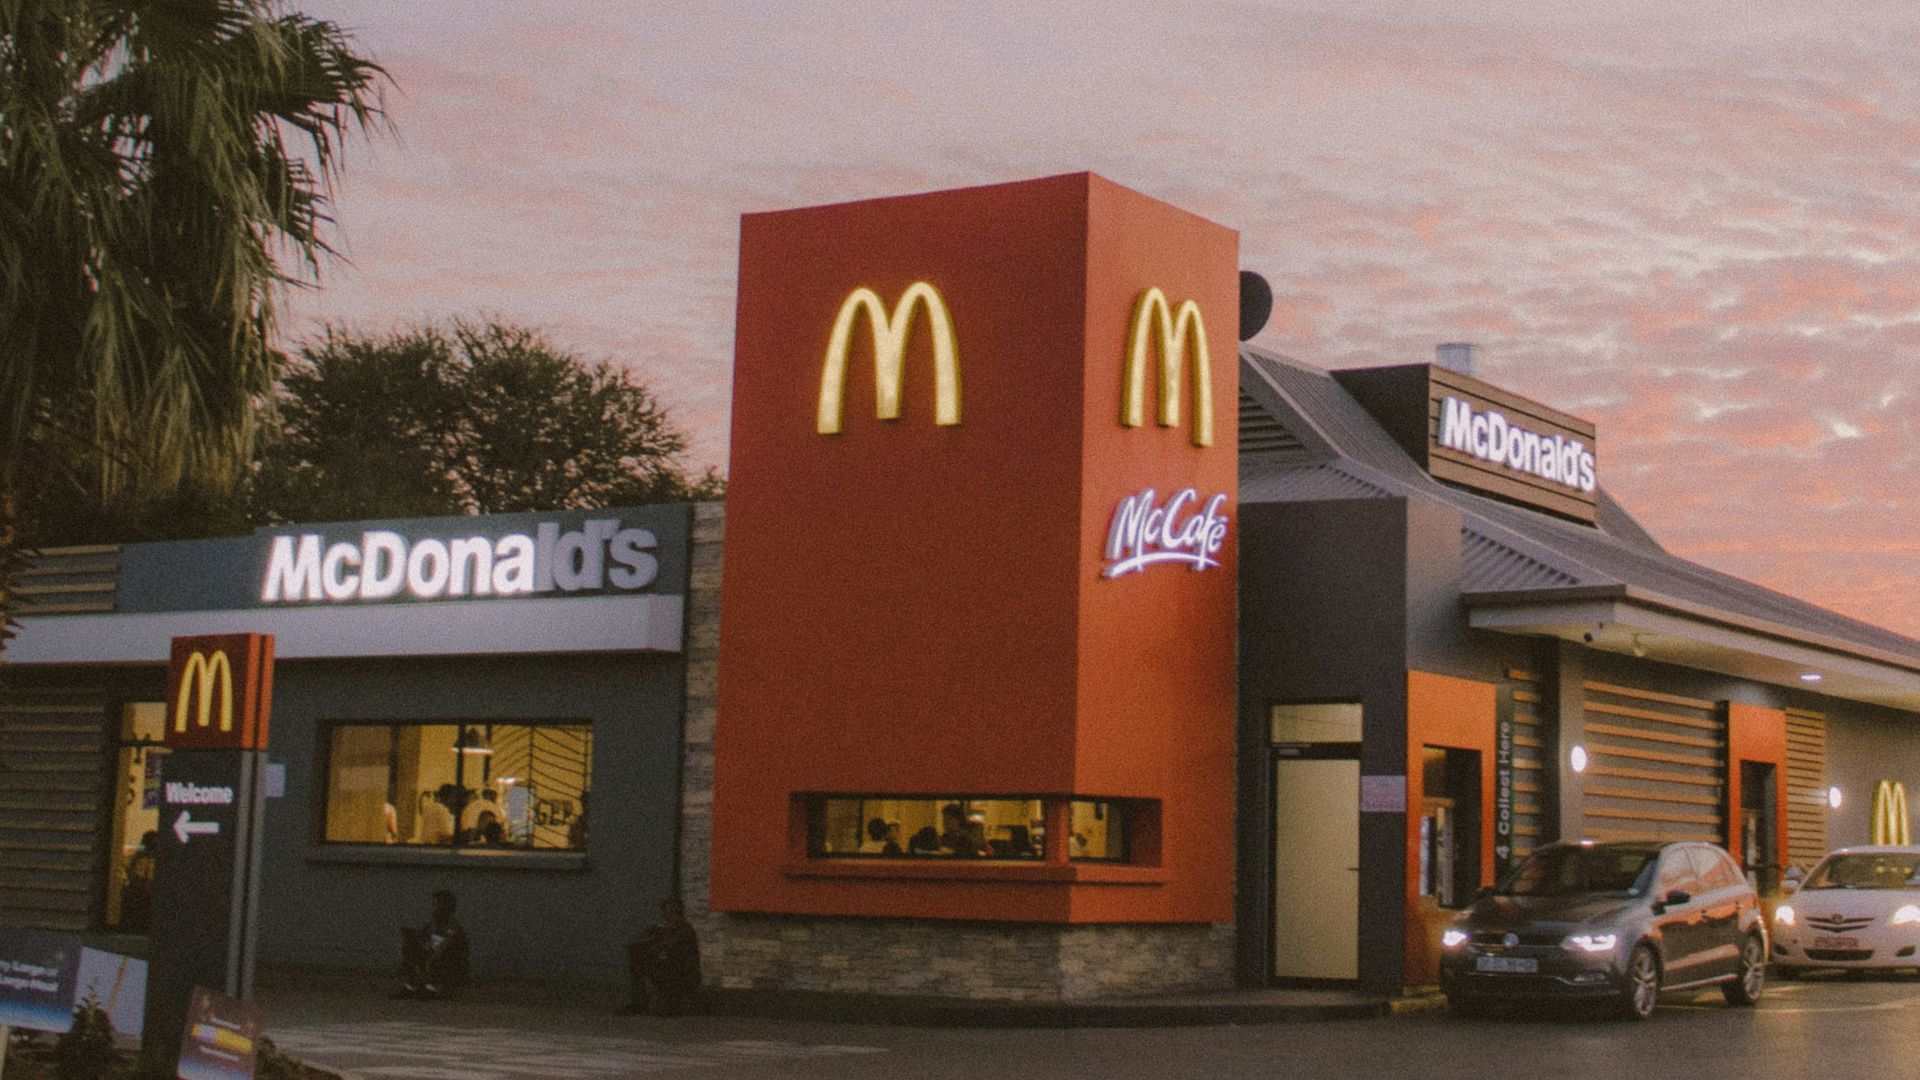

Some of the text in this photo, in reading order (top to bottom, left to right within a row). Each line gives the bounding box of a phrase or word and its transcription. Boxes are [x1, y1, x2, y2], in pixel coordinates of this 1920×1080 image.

[1438, 396, 1595, 492] McDonald's
[261, 519, 658, 600] McDonald's
[1104, 488, 1229, 573] McCafé
[1498, 721, 1510, 764] Here
[166, 782, 234, 804] Welcome
[1498, 769, 1510, 834] Collect
